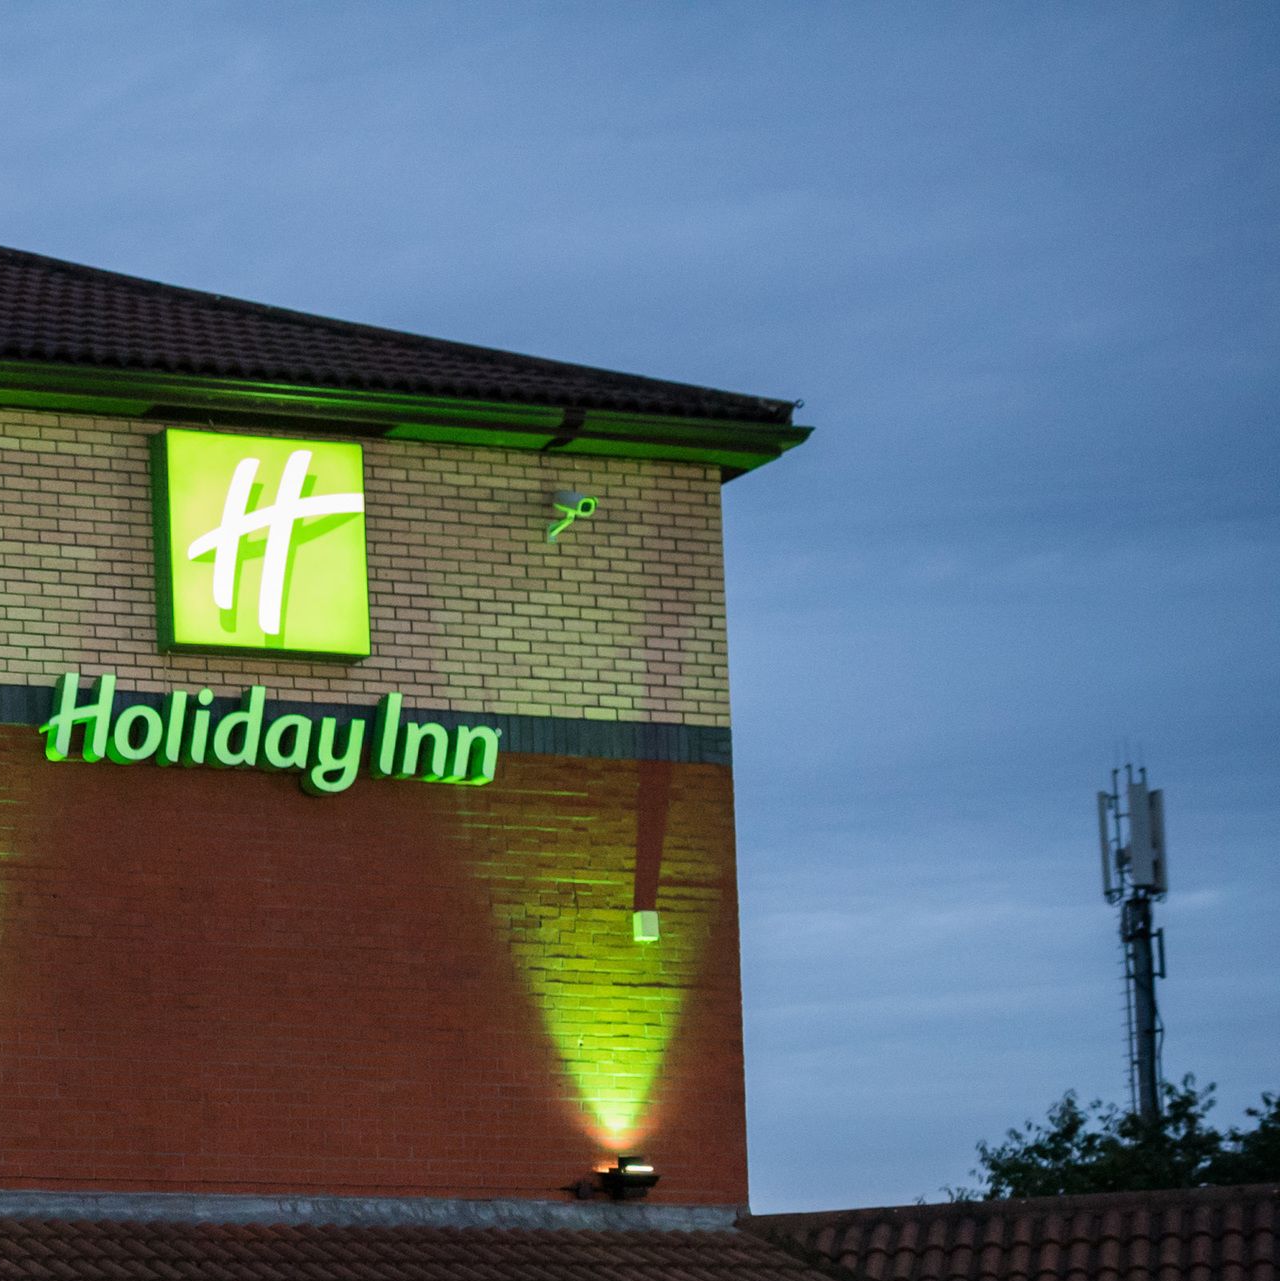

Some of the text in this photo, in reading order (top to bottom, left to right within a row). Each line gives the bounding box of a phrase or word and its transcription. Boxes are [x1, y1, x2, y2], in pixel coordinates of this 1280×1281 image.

[188, 449, 365, 635] H
[41, 672, 499, 794] Holiday Inn
